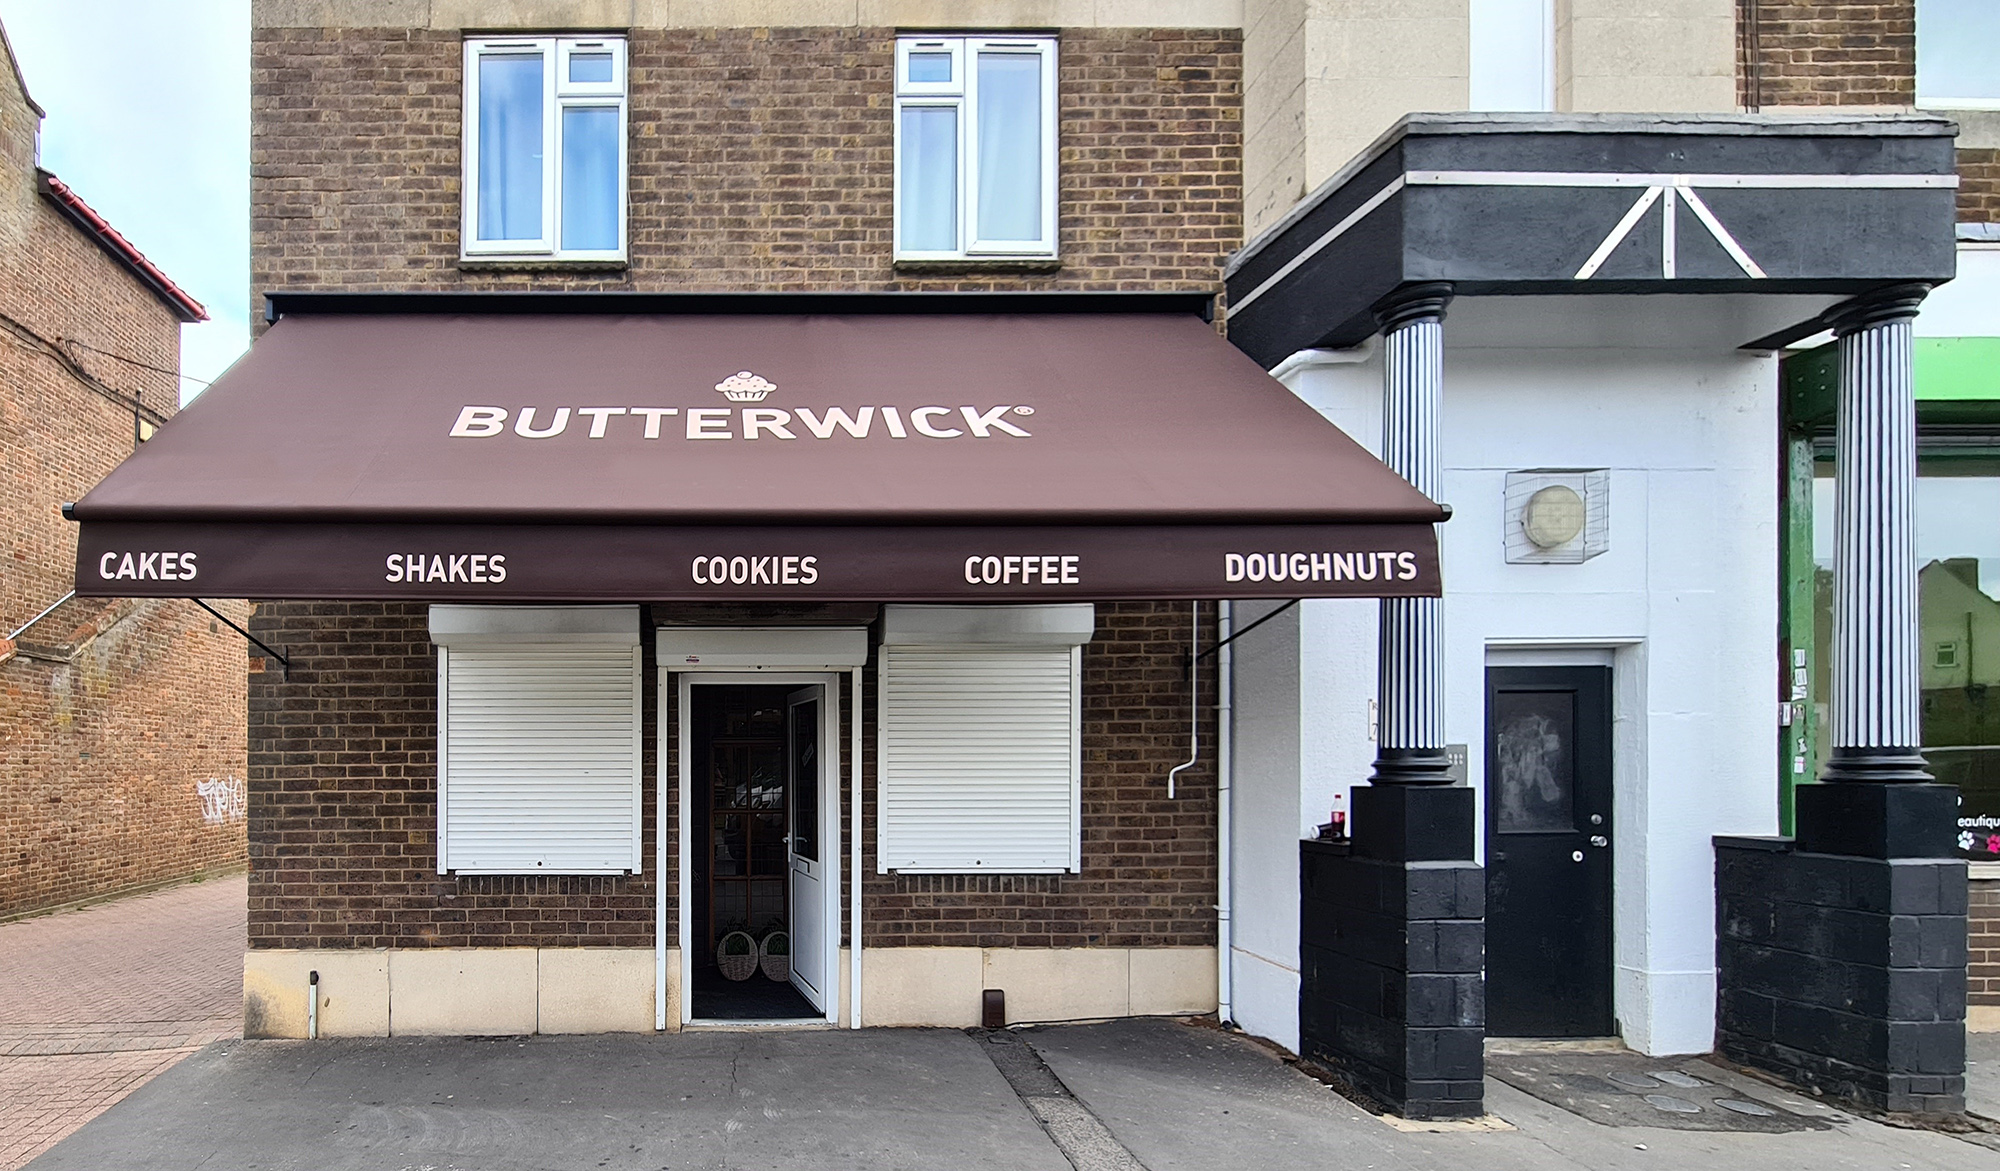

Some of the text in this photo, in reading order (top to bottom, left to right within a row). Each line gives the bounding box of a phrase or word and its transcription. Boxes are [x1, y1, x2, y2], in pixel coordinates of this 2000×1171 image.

[450, 405, 1032, 439] BUTTERWICK
[99, 552, 1417, 584] CAKES SHAKES COOKIES COFFEE DOUGHNUTS
[1957, 814, 2000, 830] eautiqu
